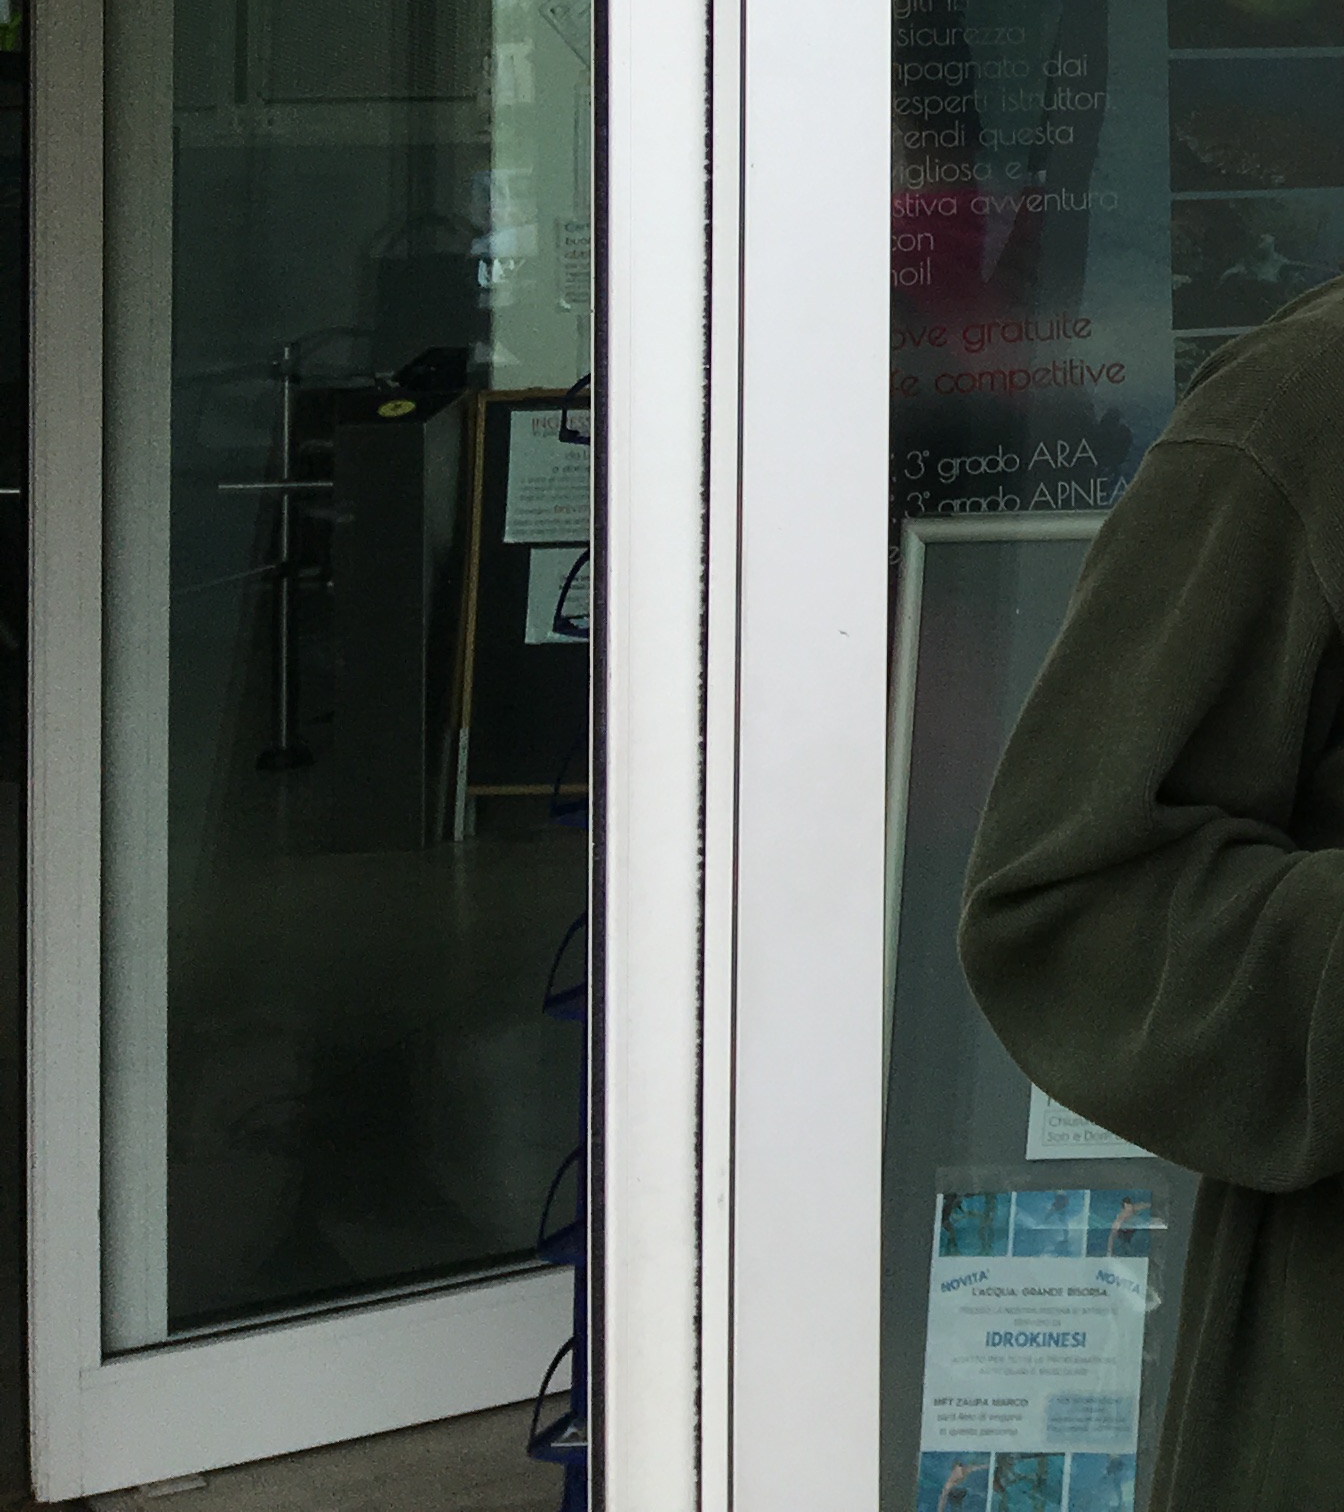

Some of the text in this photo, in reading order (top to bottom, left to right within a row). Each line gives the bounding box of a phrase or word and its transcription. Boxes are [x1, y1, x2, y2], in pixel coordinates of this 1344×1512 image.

[897, 22, 1026, 47] sicurezza
[1042, 53, 1089, 79] dai
[895, 91, 988, 121] esperti
[978, 123, 1075, 151] questa
[1005, 161, 1024, 180] e
[969, 188, 1119, 217] avventura
[962, 310, 1093, 353] gratuite
[933, 357, 1126, 397] competitive
[937, 444, 1020, 485] grado
[1027, 437, 1099, 471] ARA
[937, 485, 1021, 512] grado
[1028, 474, 1130, 511] APNEA
[984, 1330, 1087, 1348] IDROKINESI
